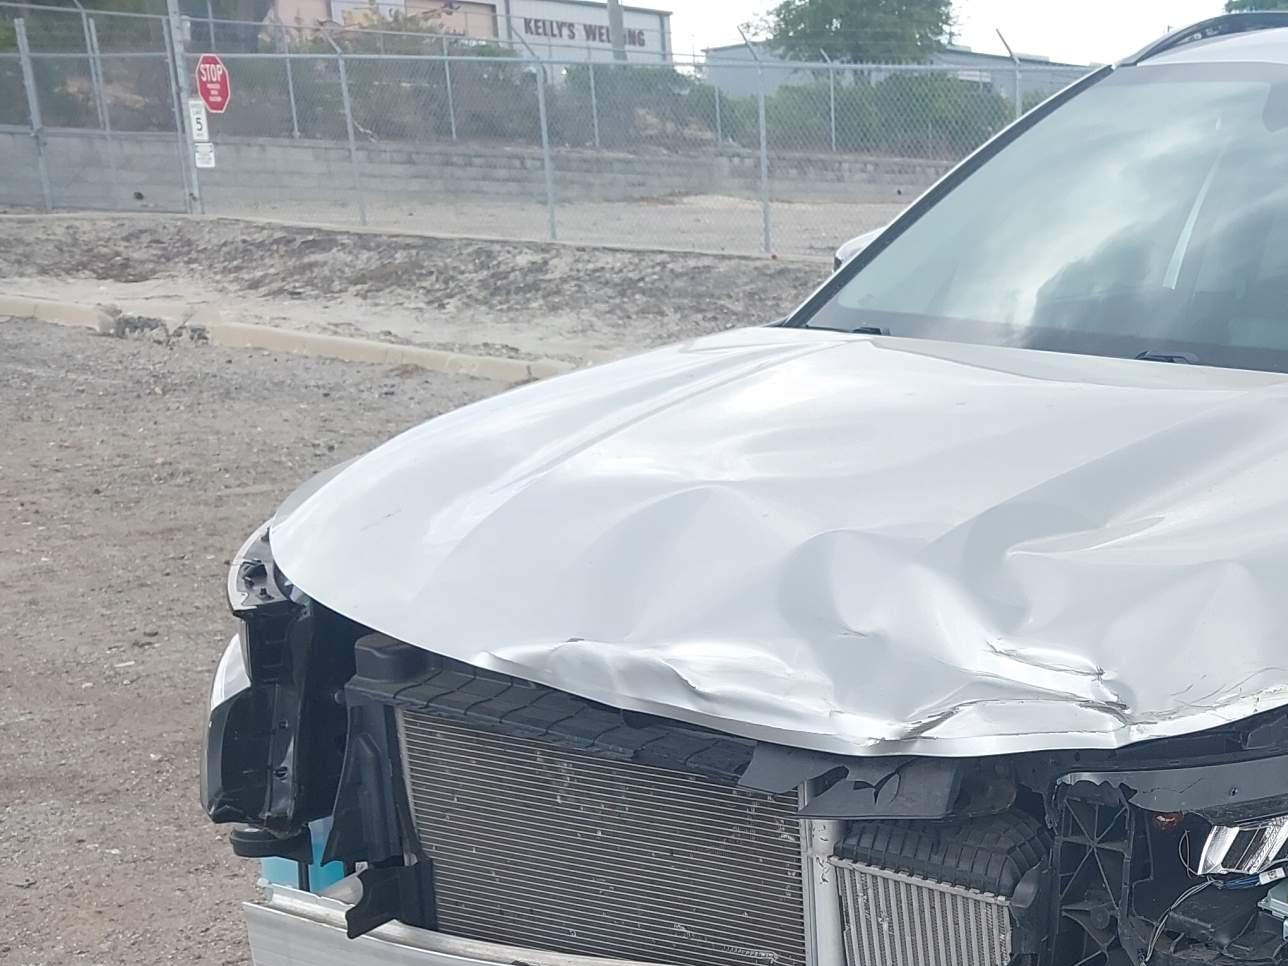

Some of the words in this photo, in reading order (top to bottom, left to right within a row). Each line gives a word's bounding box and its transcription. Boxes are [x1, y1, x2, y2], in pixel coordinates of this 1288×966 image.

[523, 17, 576, 40] KELLY'S
[200, 63, 223, 82] STOP
[195, 117, 203, 131] 5
